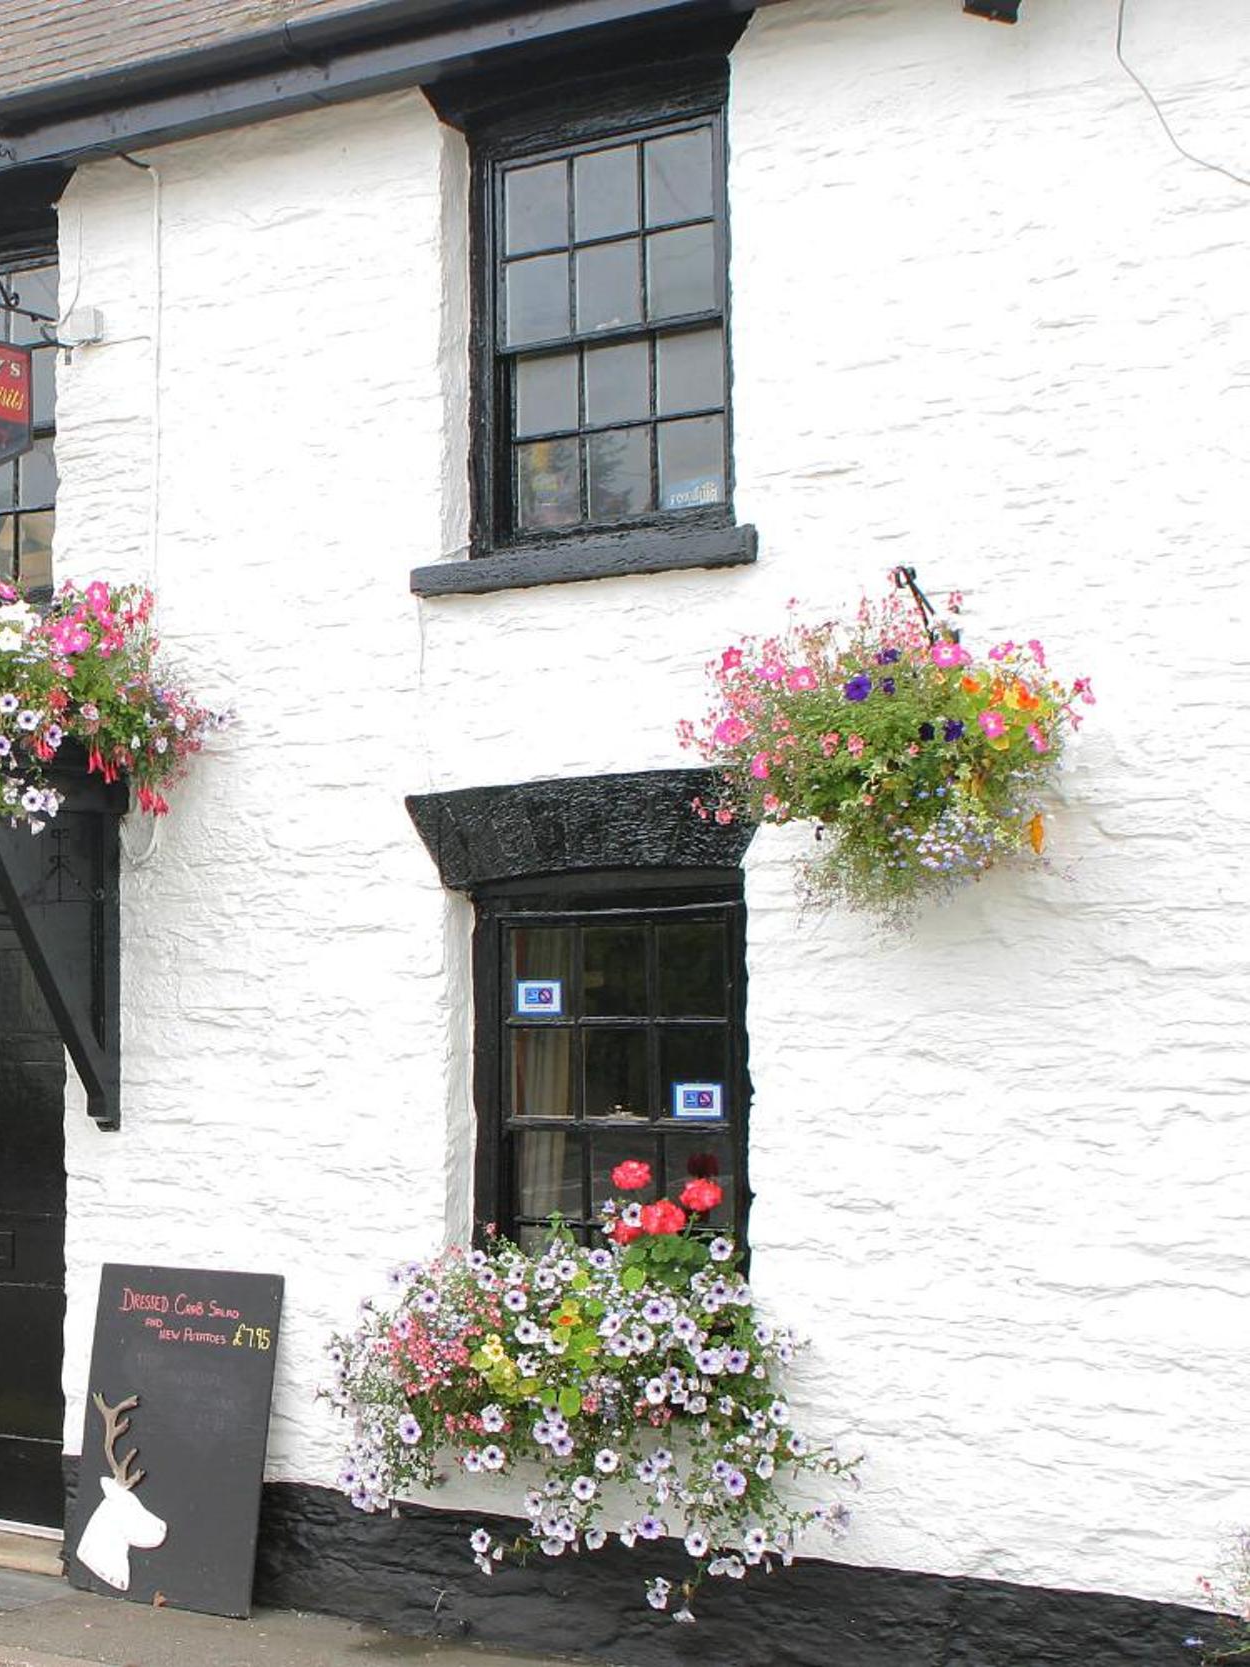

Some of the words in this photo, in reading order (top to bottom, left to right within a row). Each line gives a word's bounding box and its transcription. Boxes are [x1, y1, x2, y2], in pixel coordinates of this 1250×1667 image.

[118, 1287, 169, 1313] DRESSED
[145, 1318, 163, 1328] AND
[159, 1329, 180, 1340] NEW
[183, 1327, 227, 1345] POTATOES
